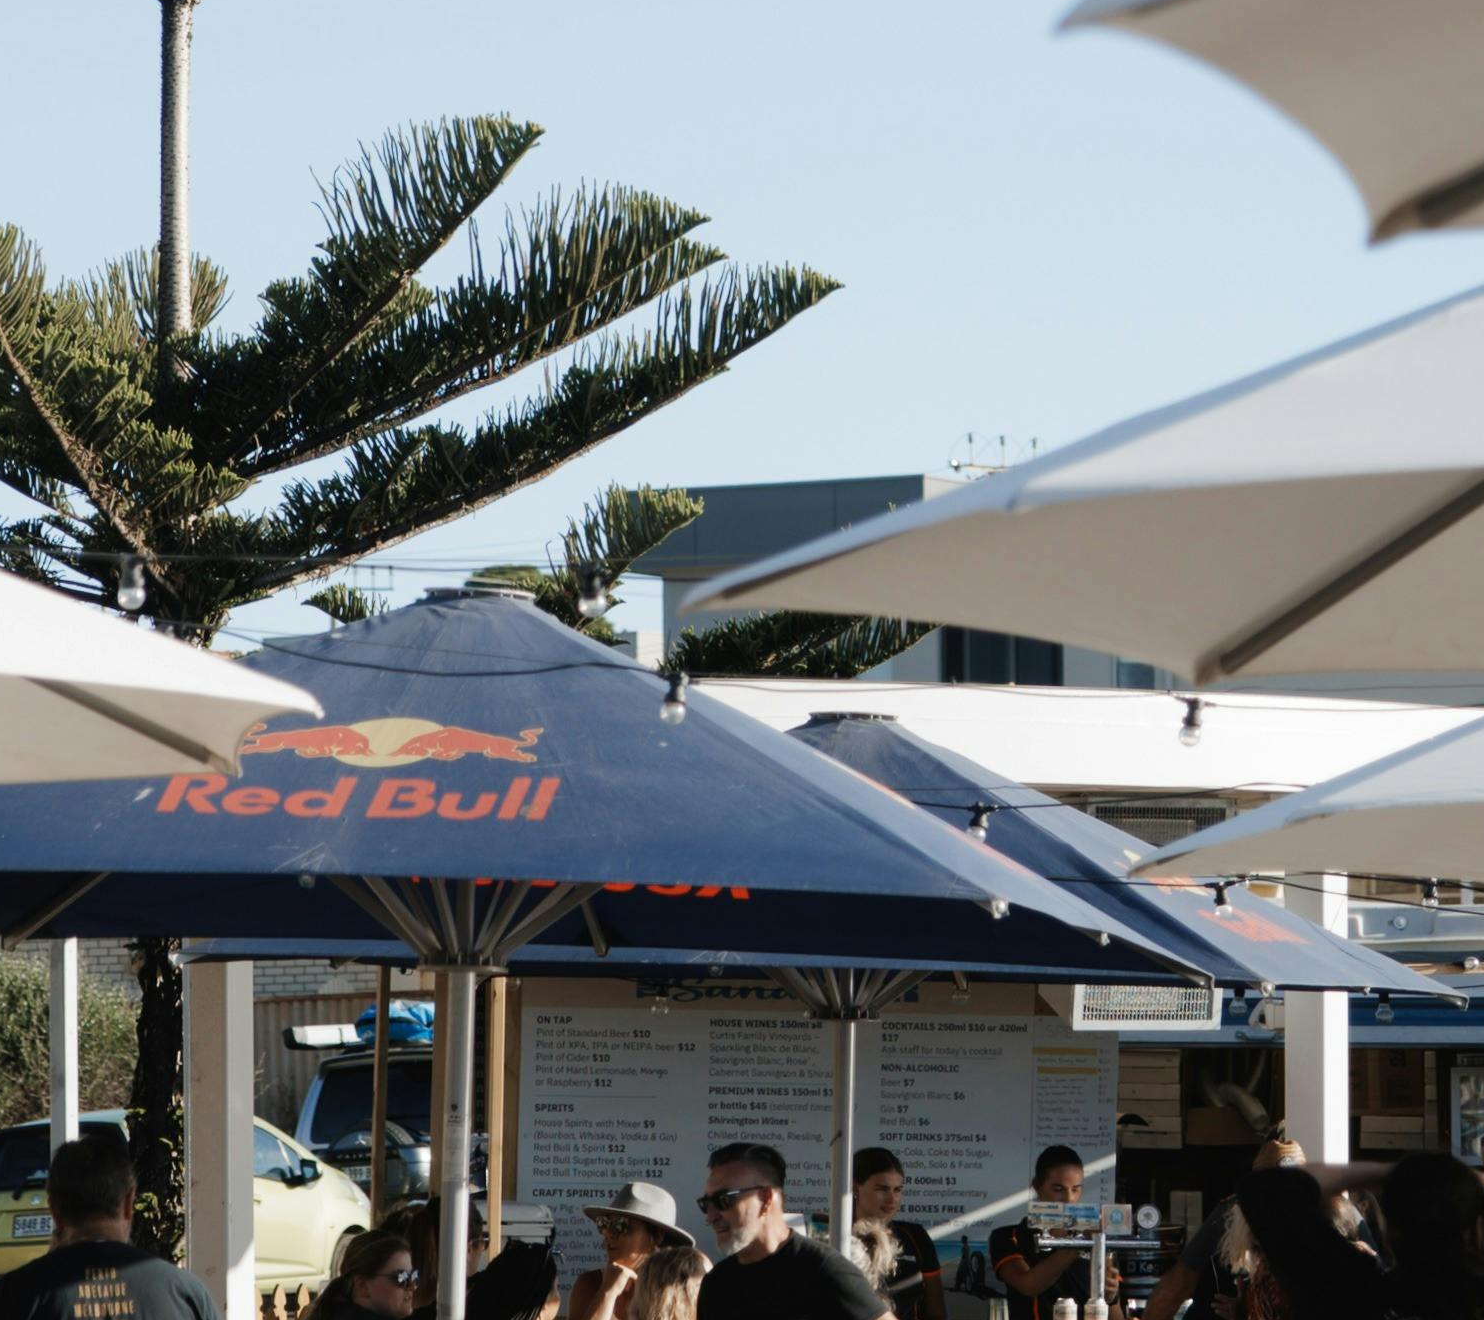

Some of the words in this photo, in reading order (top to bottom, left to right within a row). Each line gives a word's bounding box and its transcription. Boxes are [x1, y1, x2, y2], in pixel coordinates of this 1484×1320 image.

[157, 773, 357, 818] Red
[365, 776, 561, 821] Bull
[536, 1015, 551, 1024] ON
[553, 1016, 572, 1025] TAP
[710, 1019, 742, 1028] HOUSE
[745, 1020, 777, 1029] WINES
[780, 1020, 809, 1029] 150ml
[881, 1022, 935, 1032] COCKTAILS
[937, 1022, 967, 1033] 250ml
[968, 1023, 986, 1033] $10
[987, 1025, 997, 1033] or
[998, 1023, 1028, 1033] 420ml
[567, 1029, 608, 1038] Standard
[610, 1030, 630, 1038] Beer
[633, 1029, 651, 1039] $10
[881, 1033, 900, 1043] $17
[592, 1042, 608, 1051] IPA
[678, 1043, 696, 1052] $12
[881, 1045, 897, 1054] Ask
[899, 1045, 920, 1055] staff
[921, 1046, 933, 1055] for
[969, 1047, 1003, 1056] cocktail
[592, 1054, 611, 1063] $10
[880, 1063, 960, 1073] NON-ALCOHOLIC
[640, 1068, 669, 1079] Mango
[546, 1079, 592, 1089] Raspberry
[594, 1079, 612, 1088] $12
[903, 1079, 915, 1088] $7
[708, 1086, 754, 1096] PREMIUM
[756, 1087, 789, 1096] WINES
[792, 1088, 820, 1097] 150ml
[880, 1090, 925, 1101] Sauvignon
[953, 1091, 965, 1101] $6
[534, 1103, 574, 1113] SPIRITS
[720, 1102, 748, 1111] bottle
[749, 1102, 767, 1111] $45
[897, 1105, 909, 1114] $7
[643, 1120, 656, 1130] $9
[761, 1117, 789, 1126] Wines
[918, 1117, 931, 1127] $6
[879, 1132, 903, 1142] SOFT
[905, 1133, 942, 1143] DRINKS
[944, 1133, 973, 1143] 375ml
[975, 1134, 987, 1143] $4
[533, 1143, 551, 1152] Red
[553, 1143, 571, 1152] Bull
[582, 1144, 606, 1154] Spirit
[608, 1144, 626, 1154] $12
[652, 1156, 671, 1167] $12
[573, 1168, 608, 1179] Tropical
[645, 1169, 663, 1179] $12
[914, 1176, 943, 1186] 600ml
[945, 1177, 957, 1186] $3
[532, 1188, 563, 1198] CRAFT
[566, 1189, 605, 1198] SPIRITS
[923, 1189, 988, 1200] complimentary
[908, 1204, 939, 1214] BOXES
[941, 1205, 965, 1214] FREE
